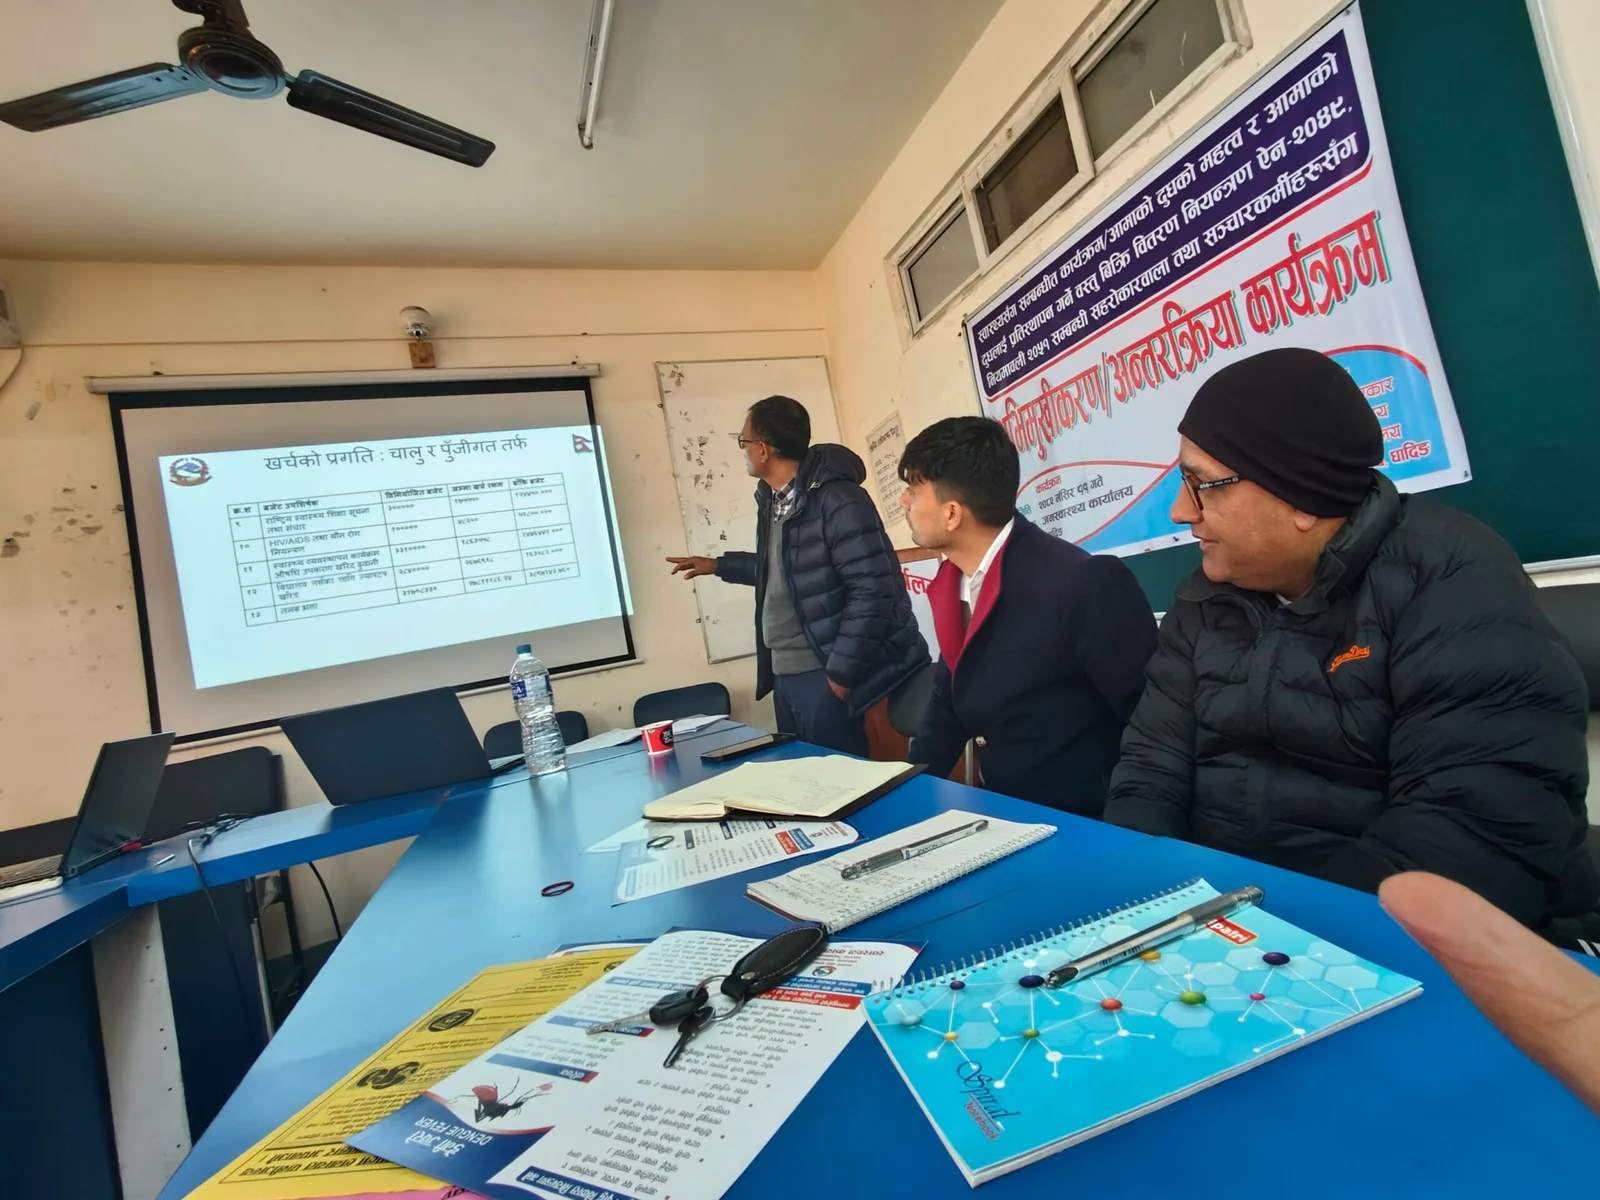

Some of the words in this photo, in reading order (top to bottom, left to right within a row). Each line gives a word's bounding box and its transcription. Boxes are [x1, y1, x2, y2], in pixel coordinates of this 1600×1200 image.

[1246, 113, 1261, 136] र
[1263, 51, 1339, 124] आमाको
[1074, 273, 1101, 299] वस्तु
[1132, 214, 1180, 259] वितरण
[1181, 159, 1254, 225] नियन्त्रण
[1240, 210, 1394, 335] कार्यक्रम
[986, 352, 1027, 390] नियमावली
[1171, 237, 1201, 269] तथा
[264, 450, 322, 471] खर्चको
[326, 446, 375, 467] प्रगति
[388, 445, 425, 465] चालु
[427, 445, 437, 458] र
[500, 434, 528, 452] तर्फ
[1090, 474, 1104, 490] गते
[263, 503, 282, 511] बजेट
[1088, 485, 1134, 509] कार्यालय
[293, 511, 325, 521] स्वास्थ्य
[266, 525, 283, 533] तथा
[269, 536, 310, 547] HIV/AIDS
[312, 533, 328, 541] तथा
[347, 529, 360, 537] रोग
[272, 559, 304, 569] स्वास्थ्य
[350, 548, 379, 559] कार्यक्रम
[301, 564, 333, 575] उपकरण
[335, 561, 354, 571] खरिद
[413, 1116, 452, 1134] FEVER
[446, 1123, 493, 1146] DENGUE
